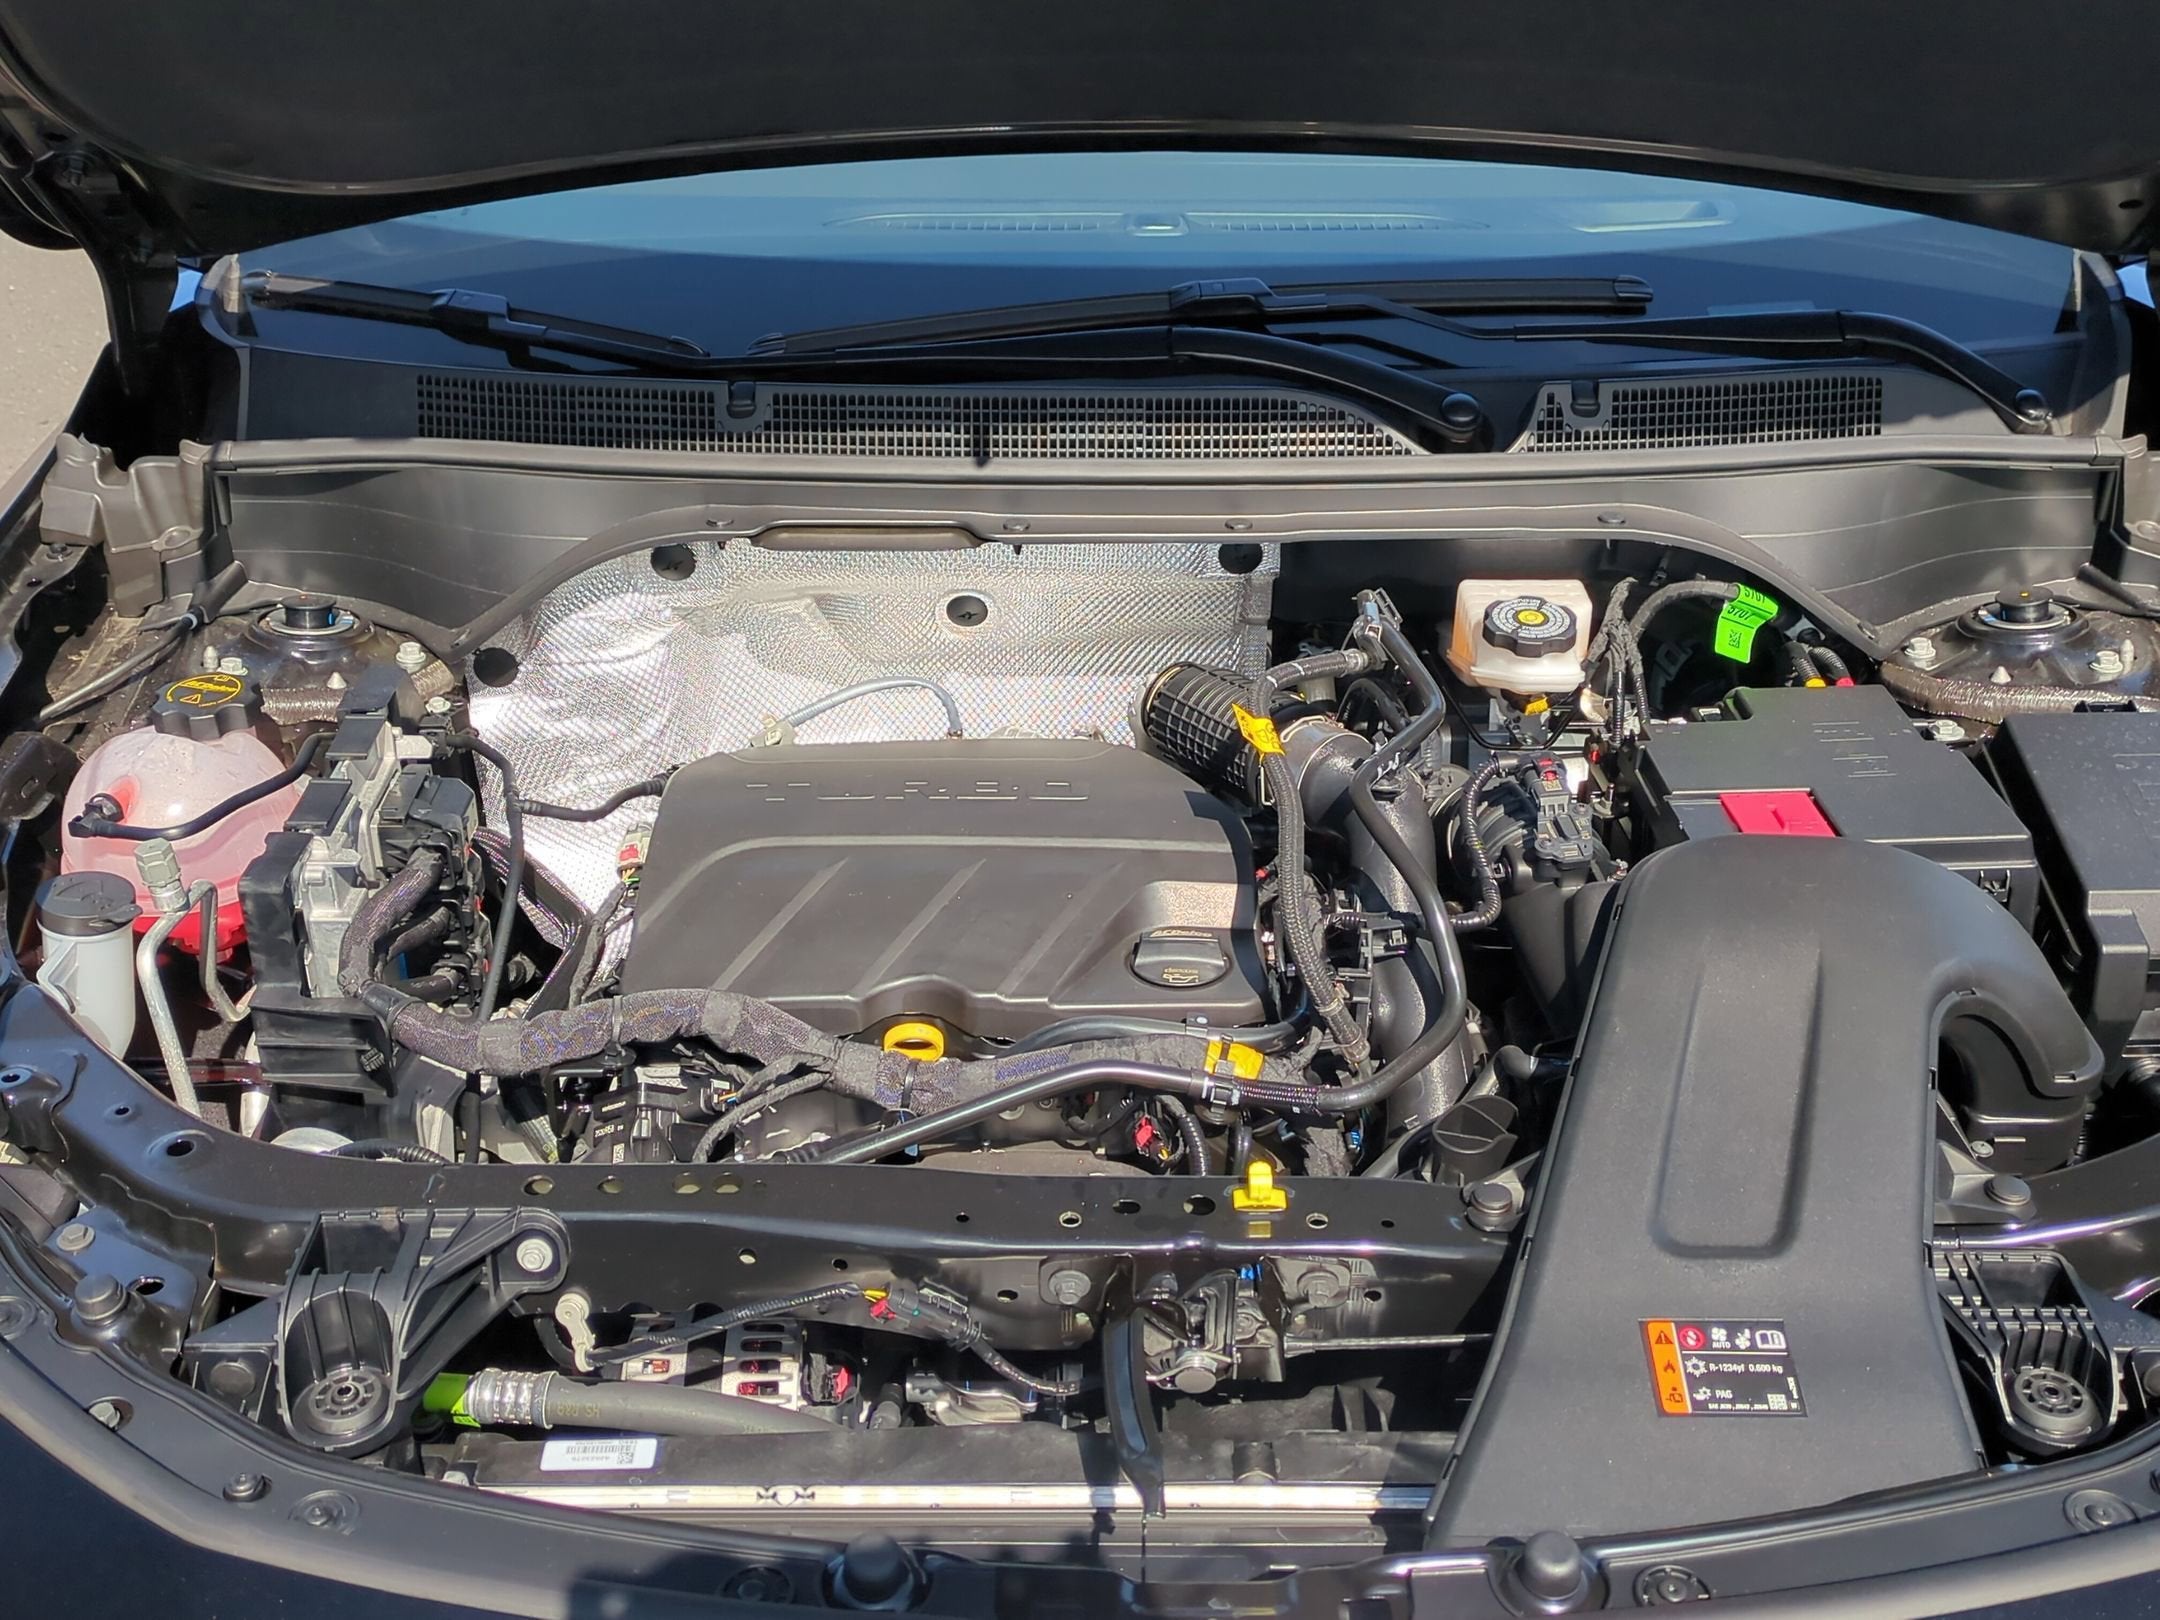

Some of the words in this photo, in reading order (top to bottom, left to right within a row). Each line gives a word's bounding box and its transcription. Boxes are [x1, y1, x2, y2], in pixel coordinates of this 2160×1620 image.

[1150, 928, 1213, 938] ACDelco
[1712, 1341, 1731, 1349] AUTO
[1715, 1389, 1733, 1399] PAG
